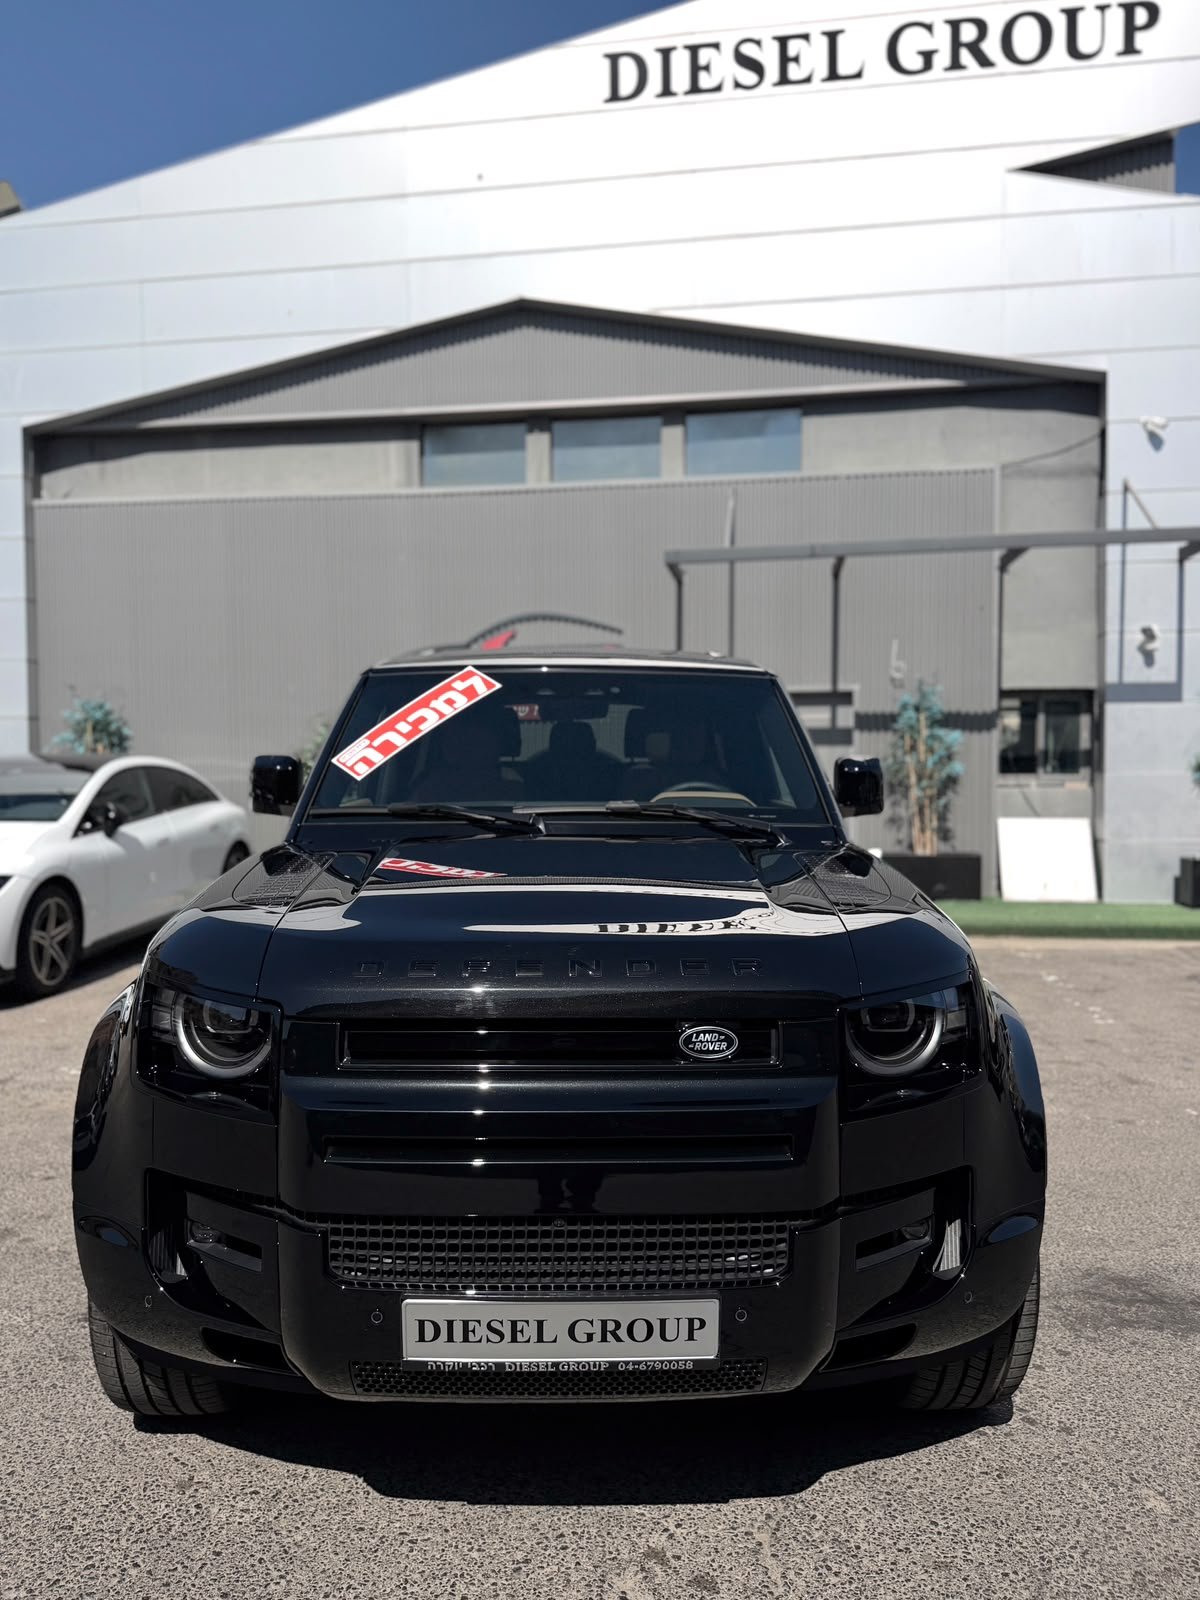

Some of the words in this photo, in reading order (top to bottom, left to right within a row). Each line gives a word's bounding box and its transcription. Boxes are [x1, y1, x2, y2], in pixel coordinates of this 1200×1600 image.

[603, 29, 865, 104] DIESEL
[886, 0, 1162, 77] GROUP
[343, 674, 489, 776] למכירה
[351, 957, 763, 979] DEFENDER
[691, 1033, 719, 1042] LAND
[694, 1042, 727, 1051] ROVER
[414, 1319, 558, 1344] DIESEL
[567, 1317, 708, 1344] GROUP
[427, 1361, 463, 1372] יוקרה
[467, 1360, 496, 1371] רכבי
[504, 1361, 556, 1372] DIESEL
[558, 1361, 609, 1371] GROUP
[618, 1360, 694, 1371] 04-6790058
